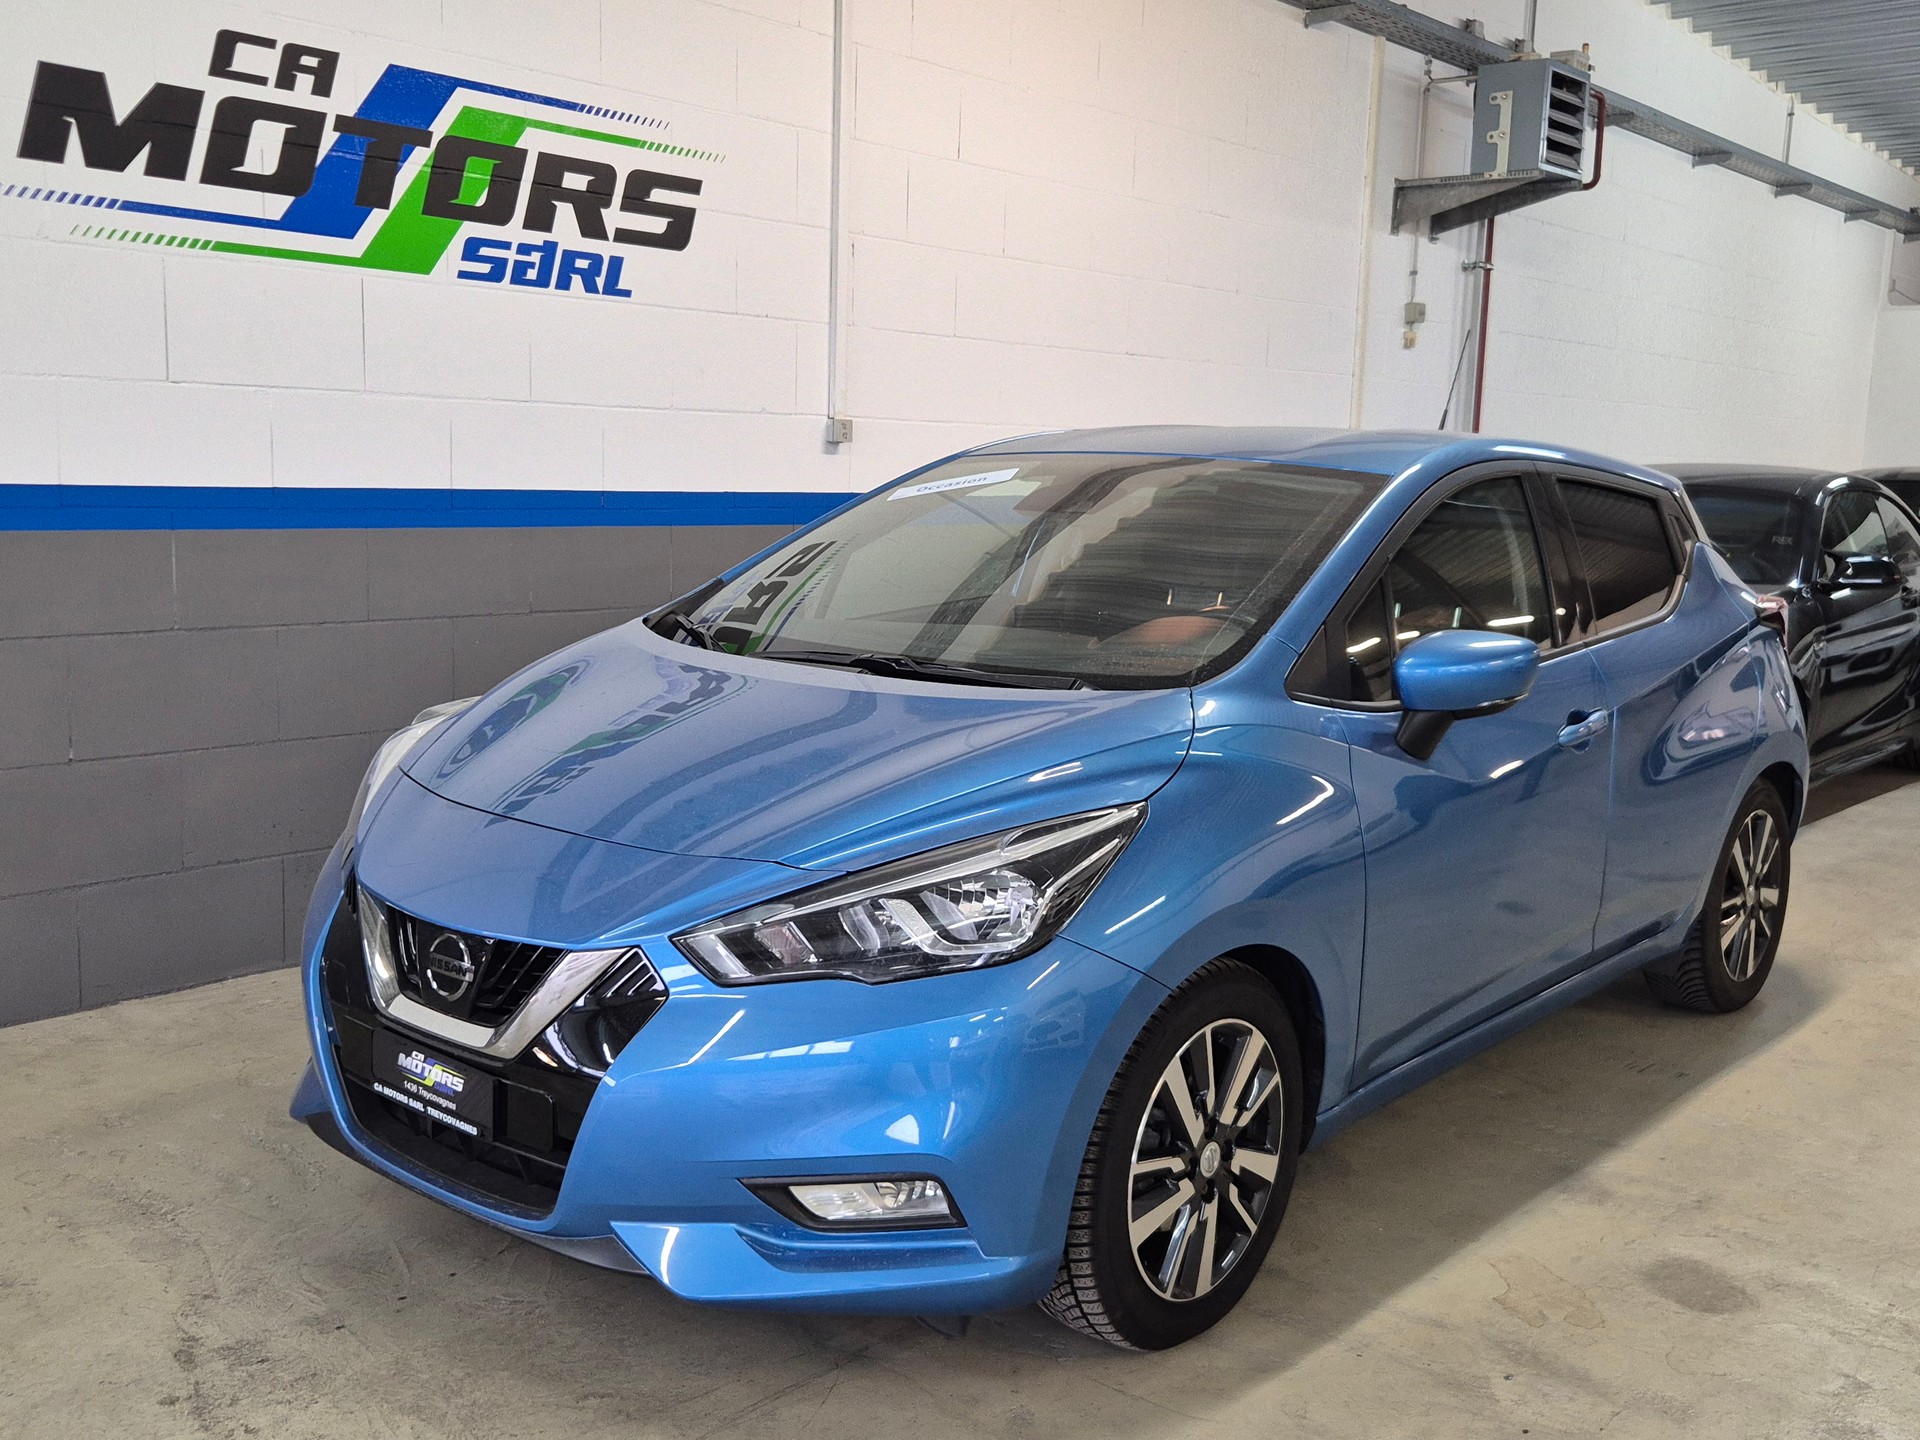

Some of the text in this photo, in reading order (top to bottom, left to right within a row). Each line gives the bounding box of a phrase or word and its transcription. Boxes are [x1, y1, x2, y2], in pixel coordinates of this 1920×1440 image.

[208, 28, 340, 98] CA
[17, 60, 703, 252] MOTORS
[916, 476, 988, 493] Occasion
[429, 955, 468, 977] NISSAN
[397, 1052, 465, 1092] MOTORS
[411, 1050, 425, 1062] CA
[373, 1082, 383, 1092] CA
[383, 1086, 409, 1103] MOTORS
[426, 1106, 478, 1136] TREYCOVAGNES
